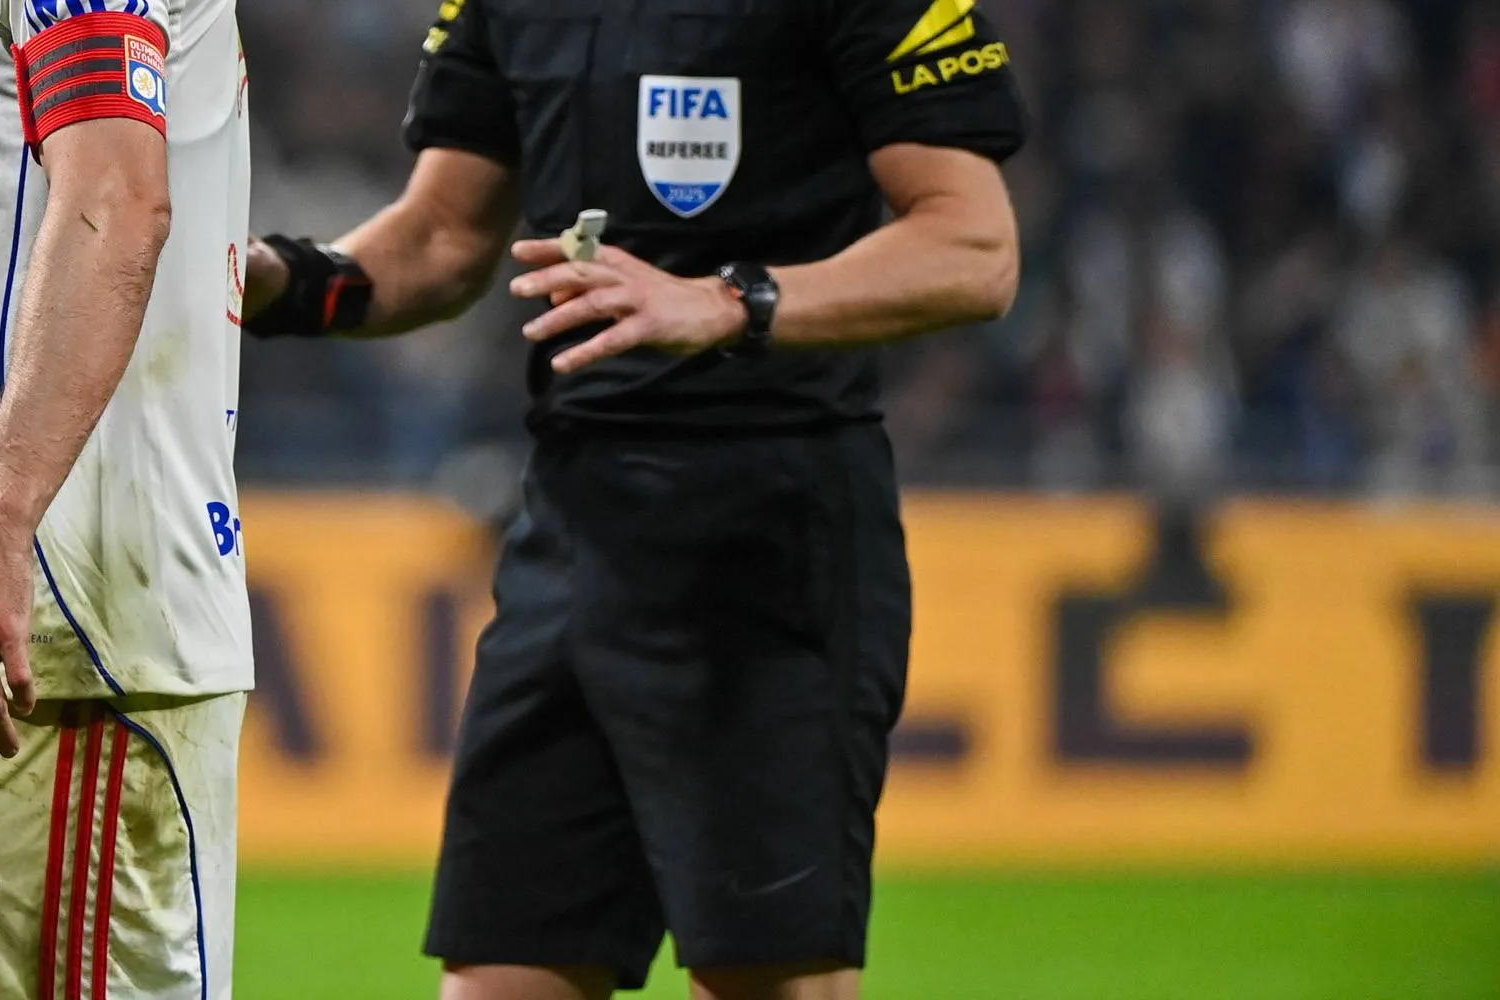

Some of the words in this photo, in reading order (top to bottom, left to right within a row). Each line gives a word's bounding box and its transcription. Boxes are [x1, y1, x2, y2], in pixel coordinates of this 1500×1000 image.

[891, 64, 939, 95] LA
[648, 87, 728, 119] FIFA
[646, 141, 729, 160] REFEREE
